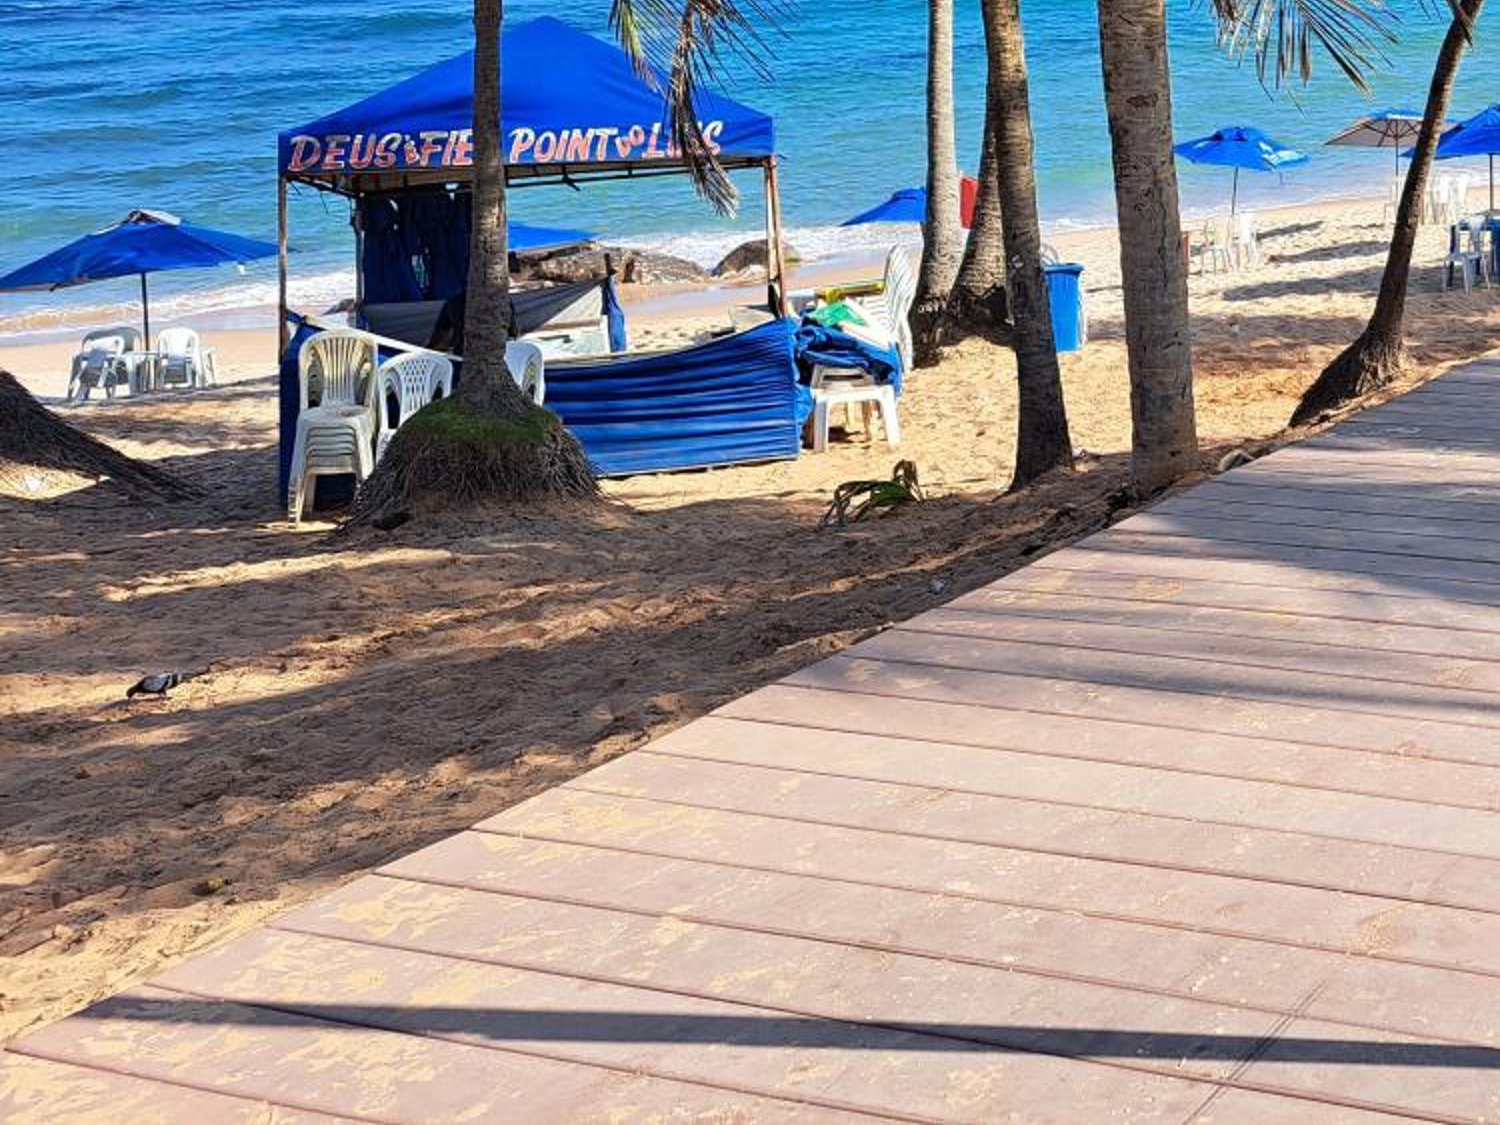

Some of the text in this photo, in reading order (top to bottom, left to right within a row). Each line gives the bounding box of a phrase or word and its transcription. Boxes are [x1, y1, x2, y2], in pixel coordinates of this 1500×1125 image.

[288, 131, 402, 172] DEUS
[416, 129, 475, 167] FIE
[508, 126, 619, 164] POINT
[641, 120, 723, 159] LS
